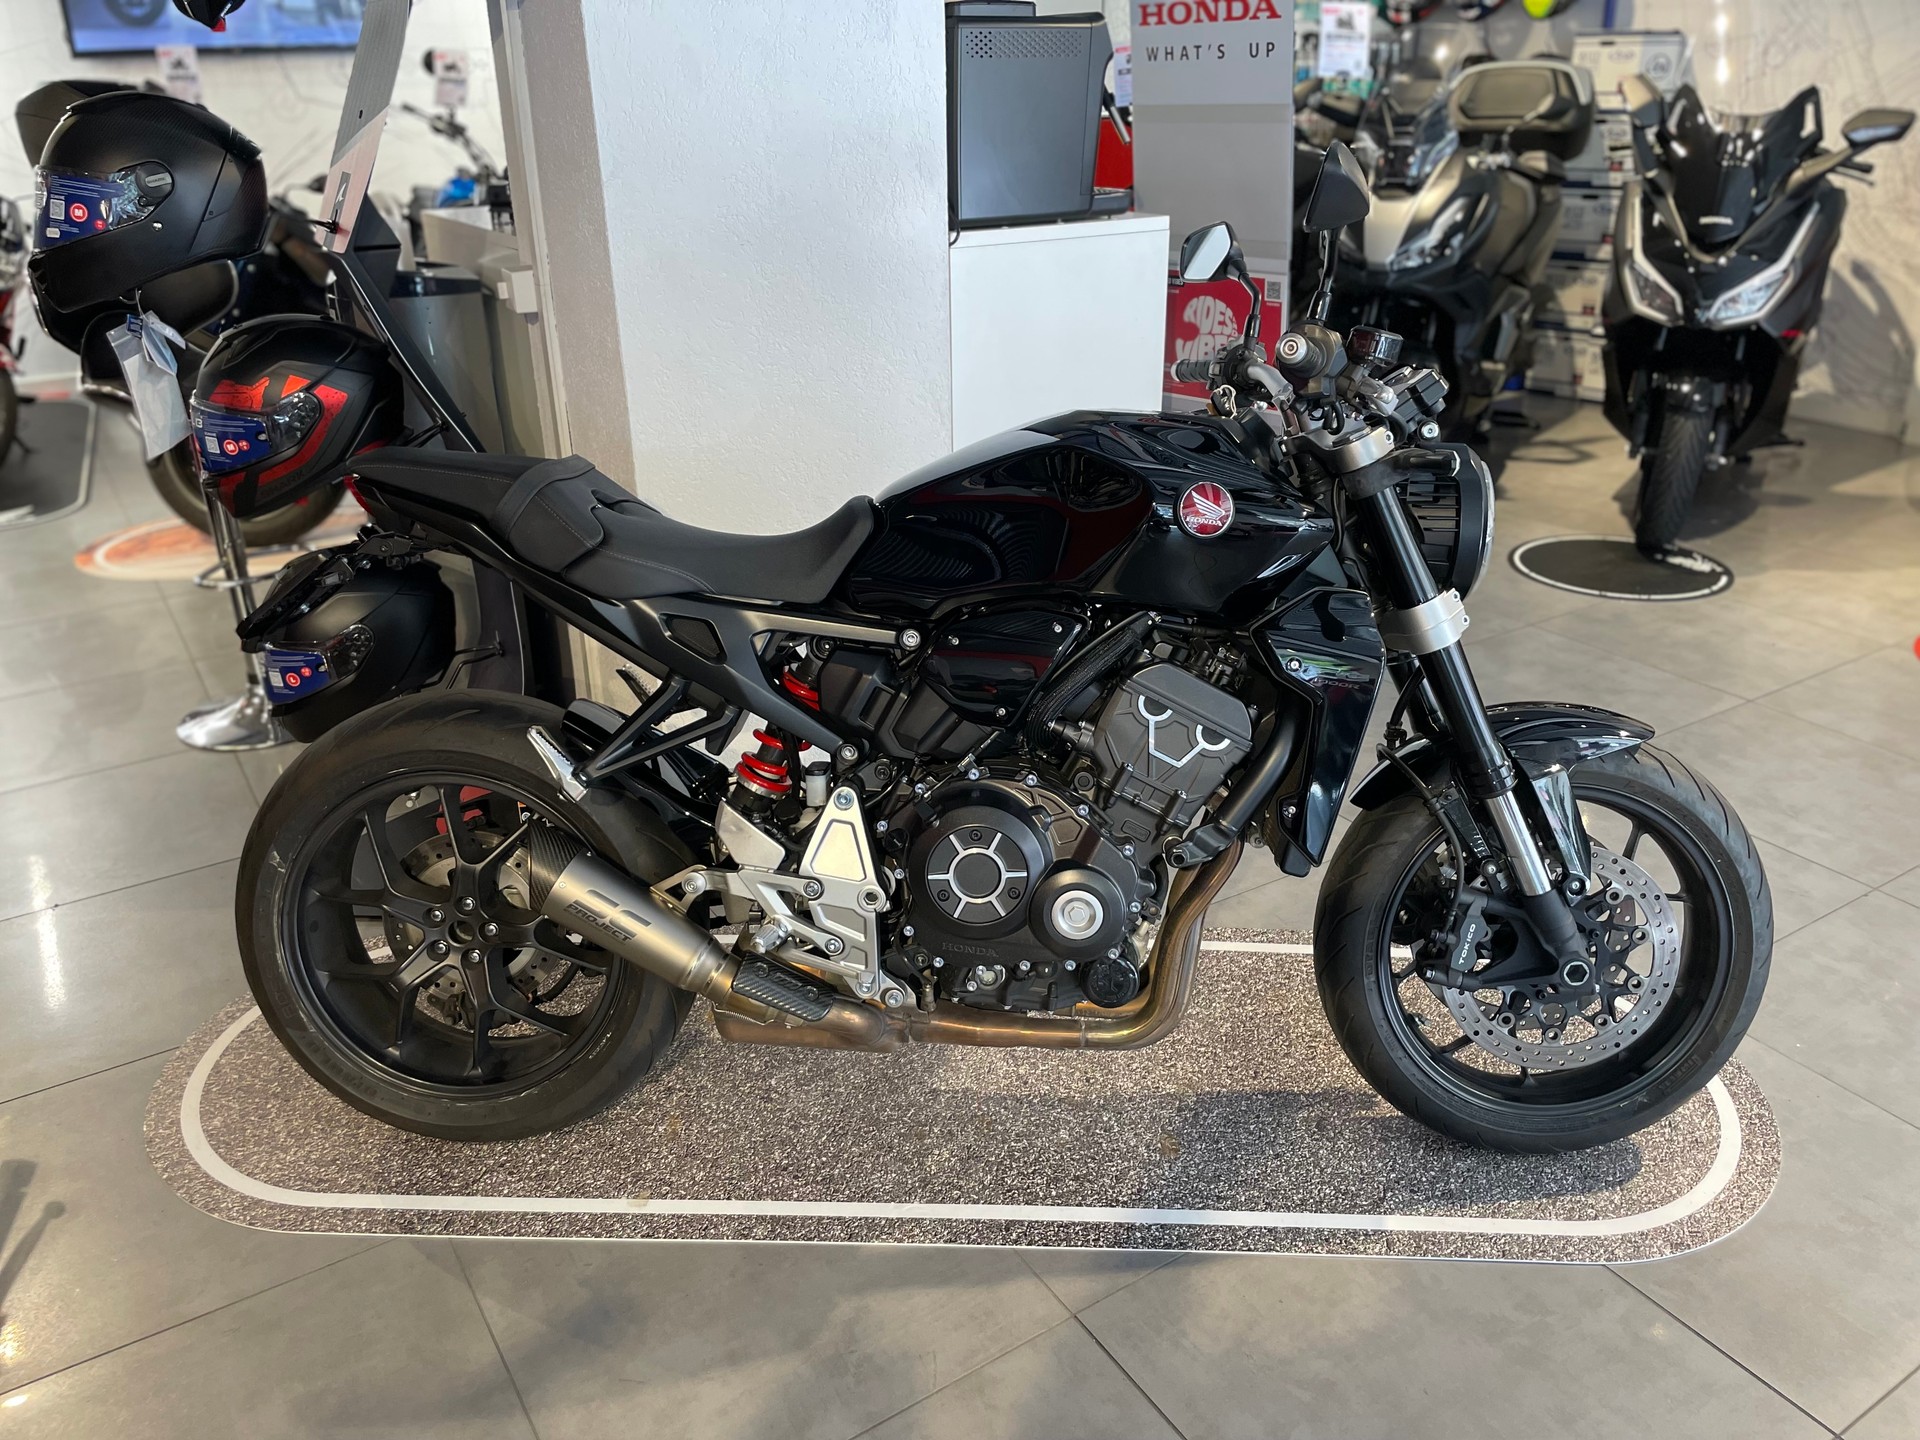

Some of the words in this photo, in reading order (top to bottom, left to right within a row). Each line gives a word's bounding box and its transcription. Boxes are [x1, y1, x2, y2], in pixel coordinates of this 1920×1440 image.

[1138, 0, 1281, 26] HONDA
[1146, 44, 1225, 62] WHAT'S
[1249, 42, 1275, 58] UP
[1183, 295, 1234, 335] RIDES
[1175, 335, 1239, 361] VIBE
[1185, 515, 1223, 527] HONDA
[564, 903, 633, 943] PROJECT
[942, 942, 999, 957] HONDA
[1458, 923, 1476, 965] TOKICO
